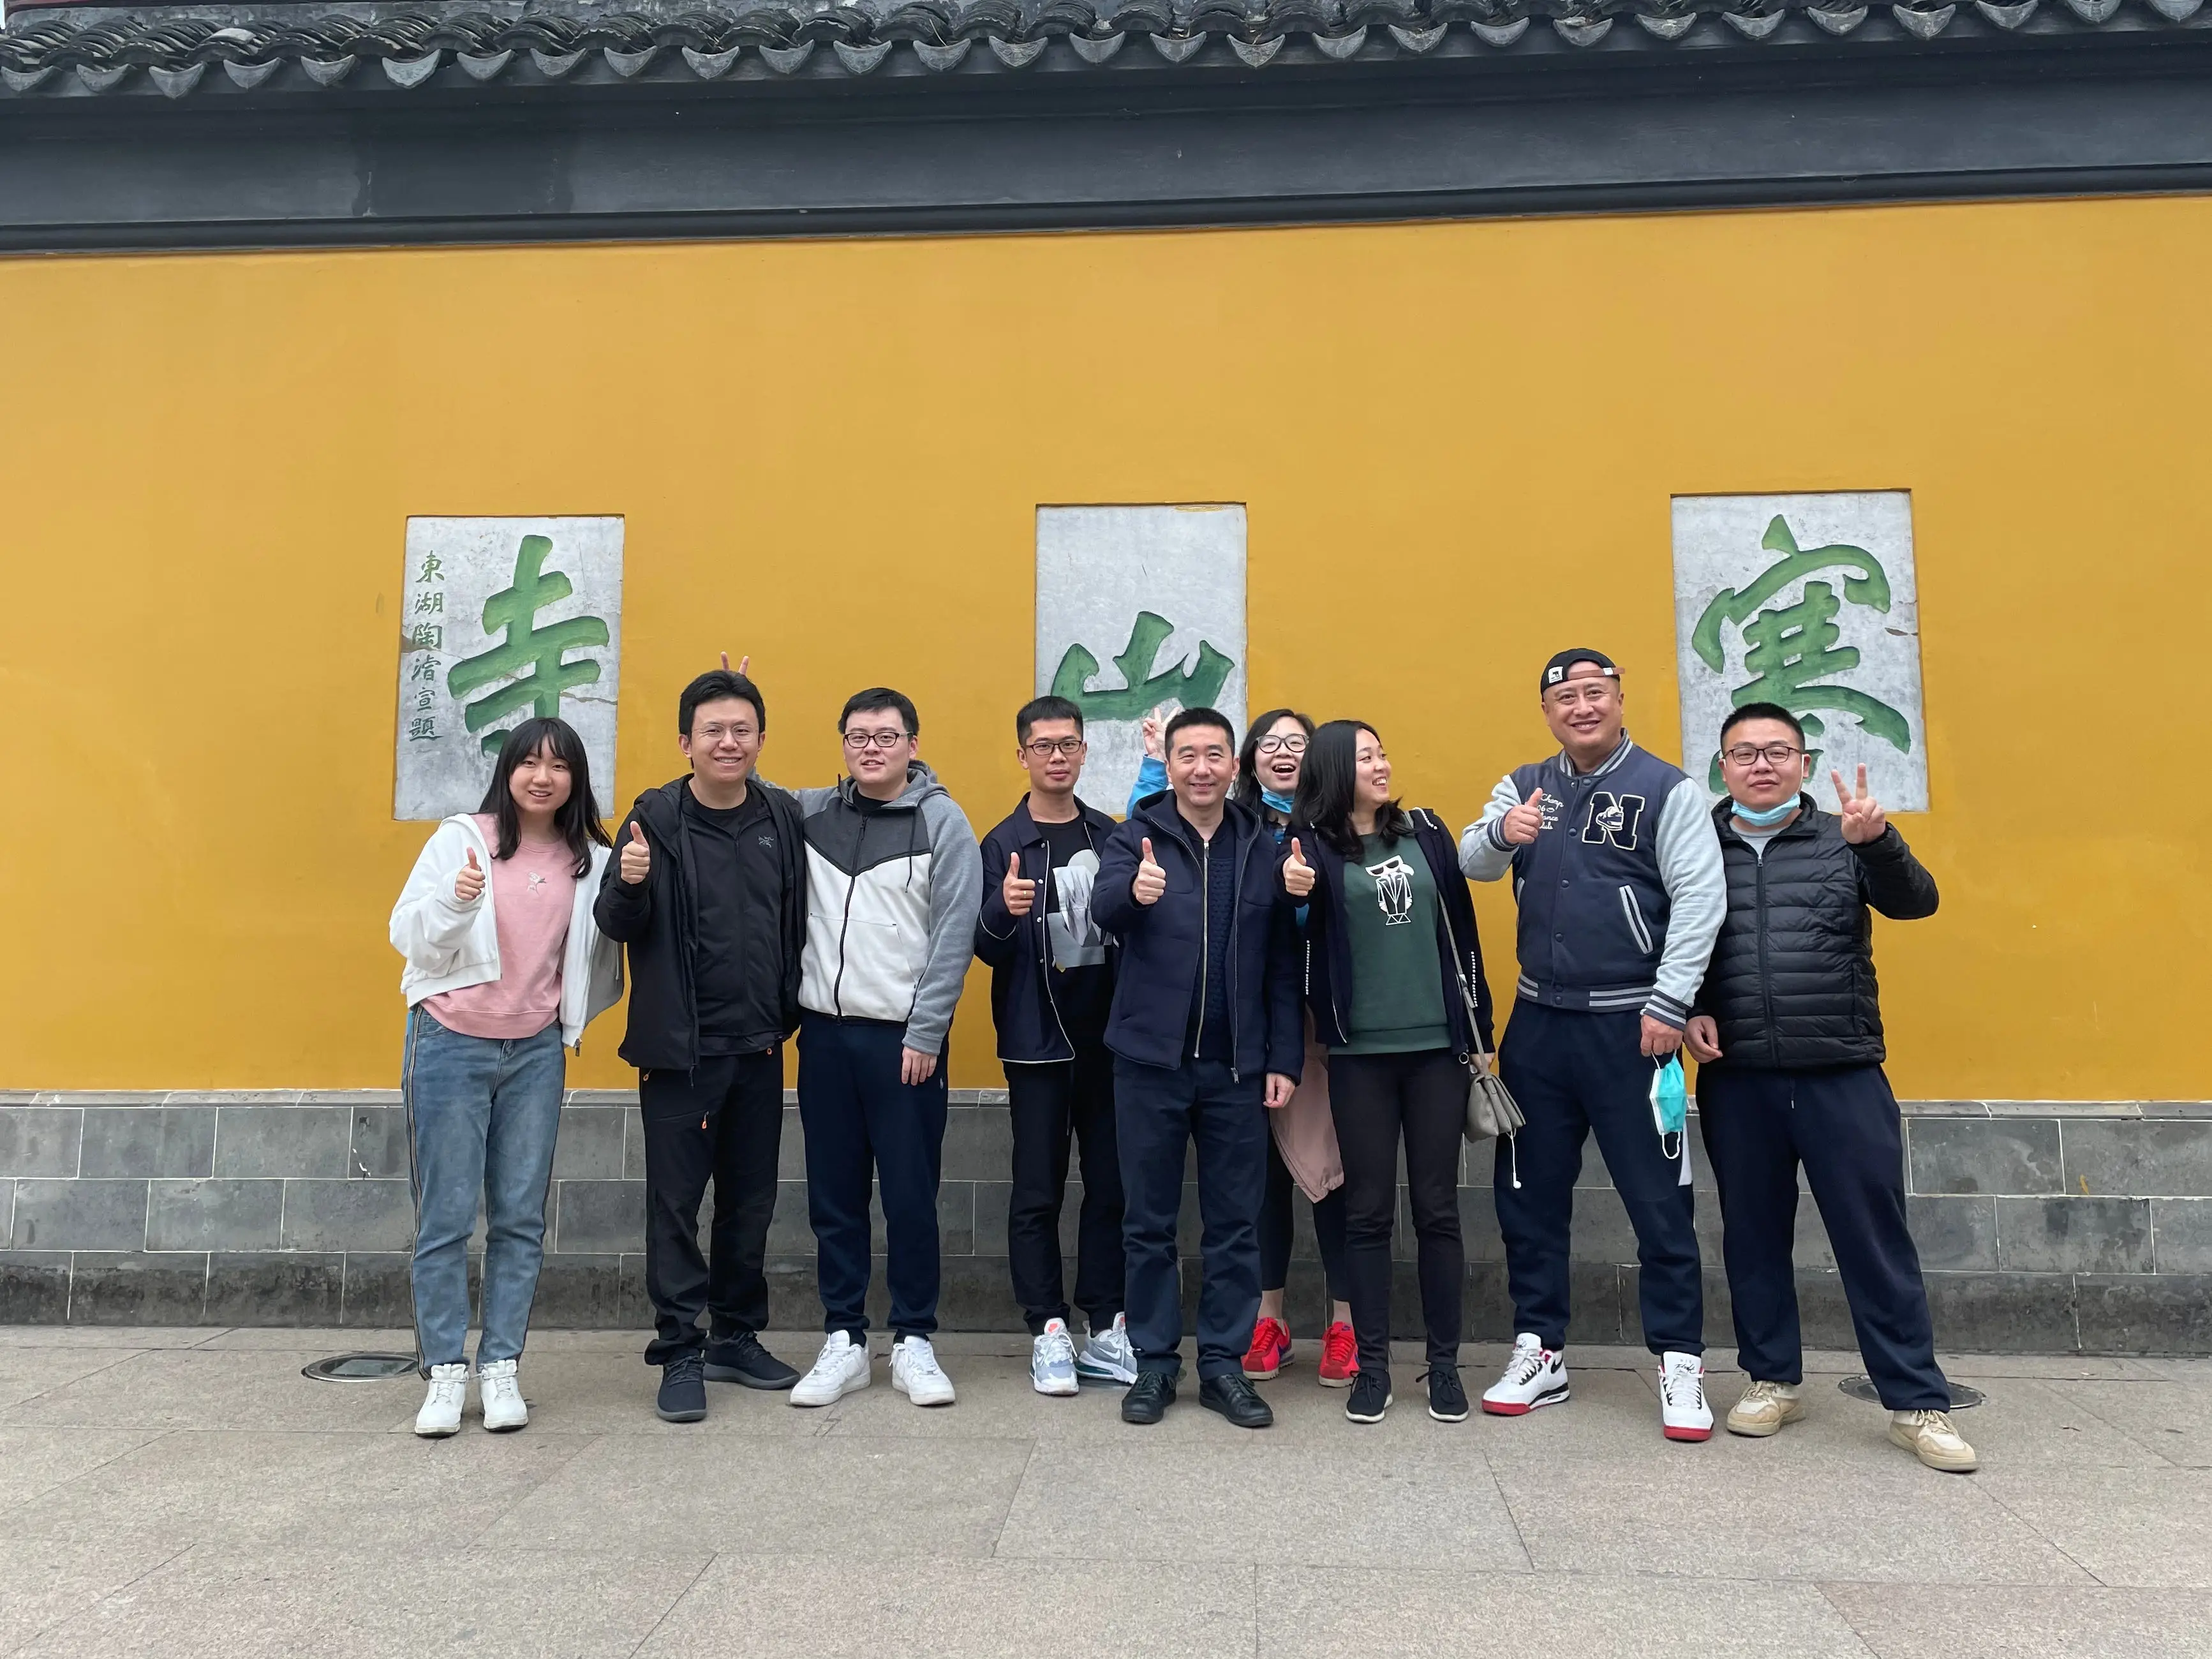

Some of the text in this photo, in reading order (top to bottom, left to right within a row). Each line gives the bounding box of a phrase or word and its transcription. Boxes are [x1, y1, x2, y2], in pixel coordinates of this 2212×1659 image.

[447, 535, 610, 758] 寺
[1050, 611, 1236, 722] 山
[1691, 514, 1911, 796] 寒
[1582, 791, 1645, 851] N
